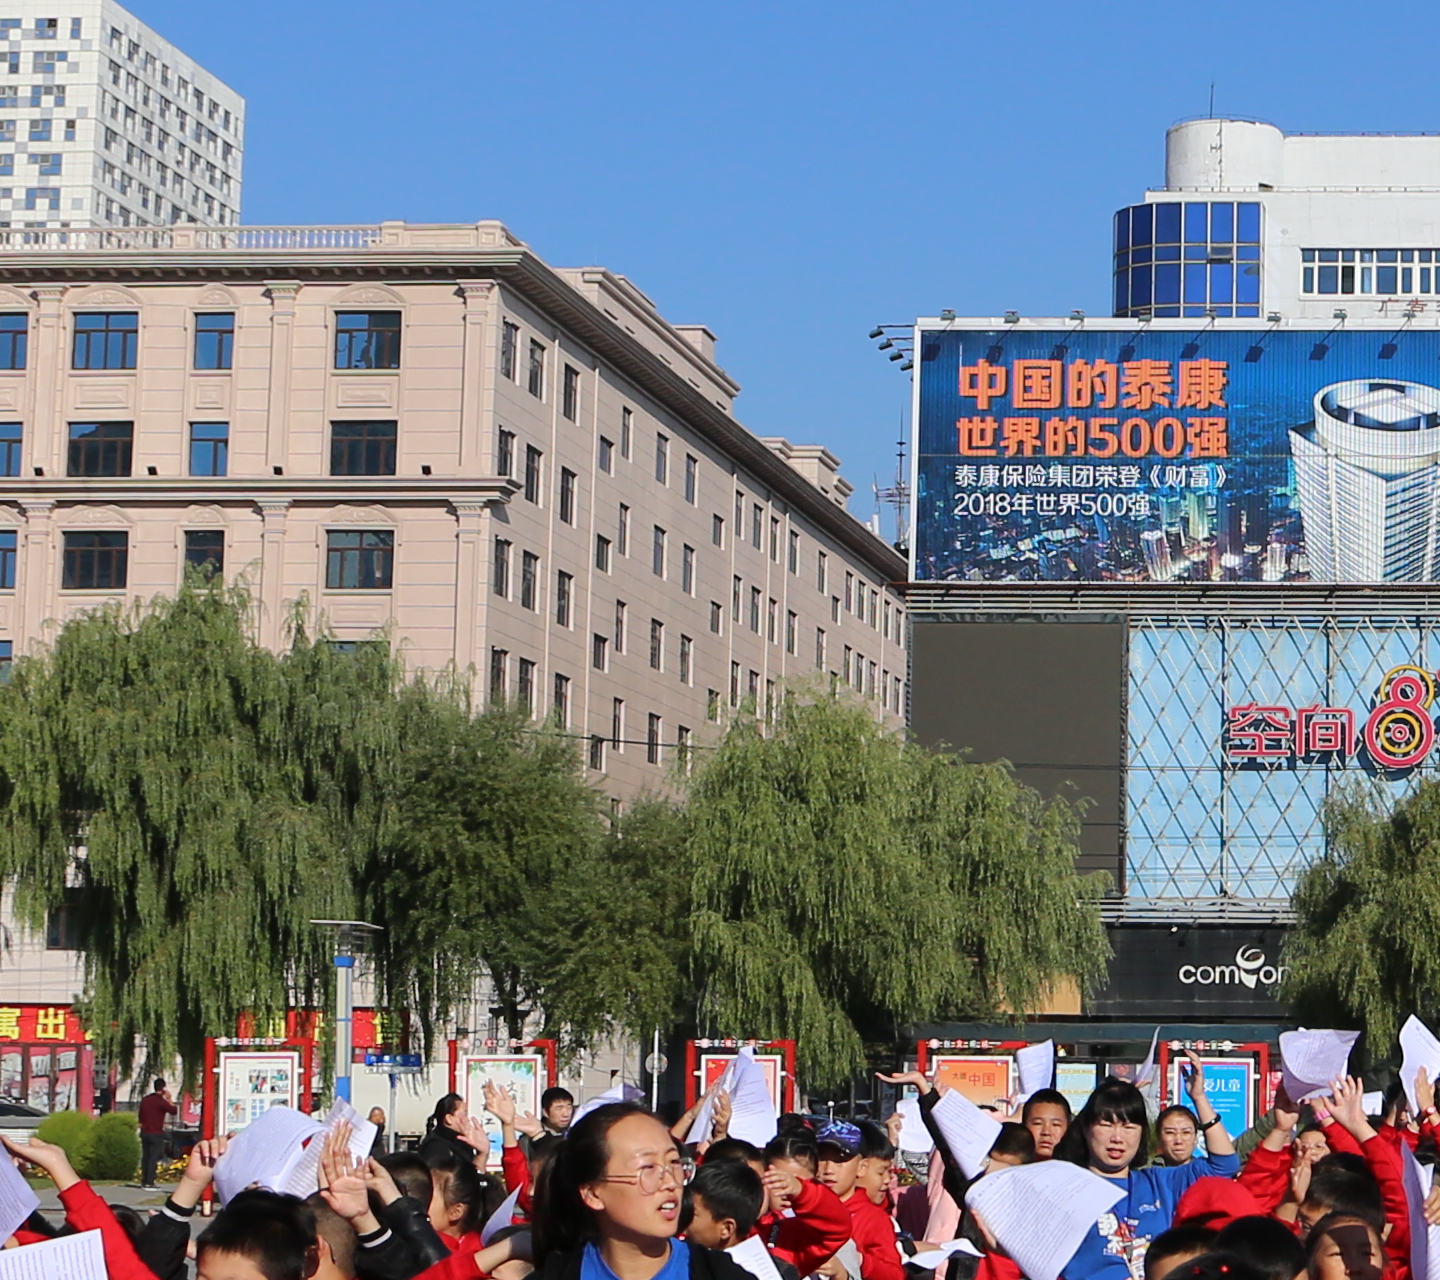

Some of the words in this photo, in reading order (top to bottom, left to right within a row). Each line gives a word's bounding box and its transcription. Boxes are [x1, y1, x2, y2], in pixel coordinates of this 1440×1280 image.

[959, 358, 1228, 410] 中国的泰康
[957, 416, 1228, 458] 世界的500强
[954, 465, 1228, 488] 泰康保险集团荣登《财富》
[953, 493, 1150, 516] 2018年世界500强
[968, 1072, 995, 1087] 中国
